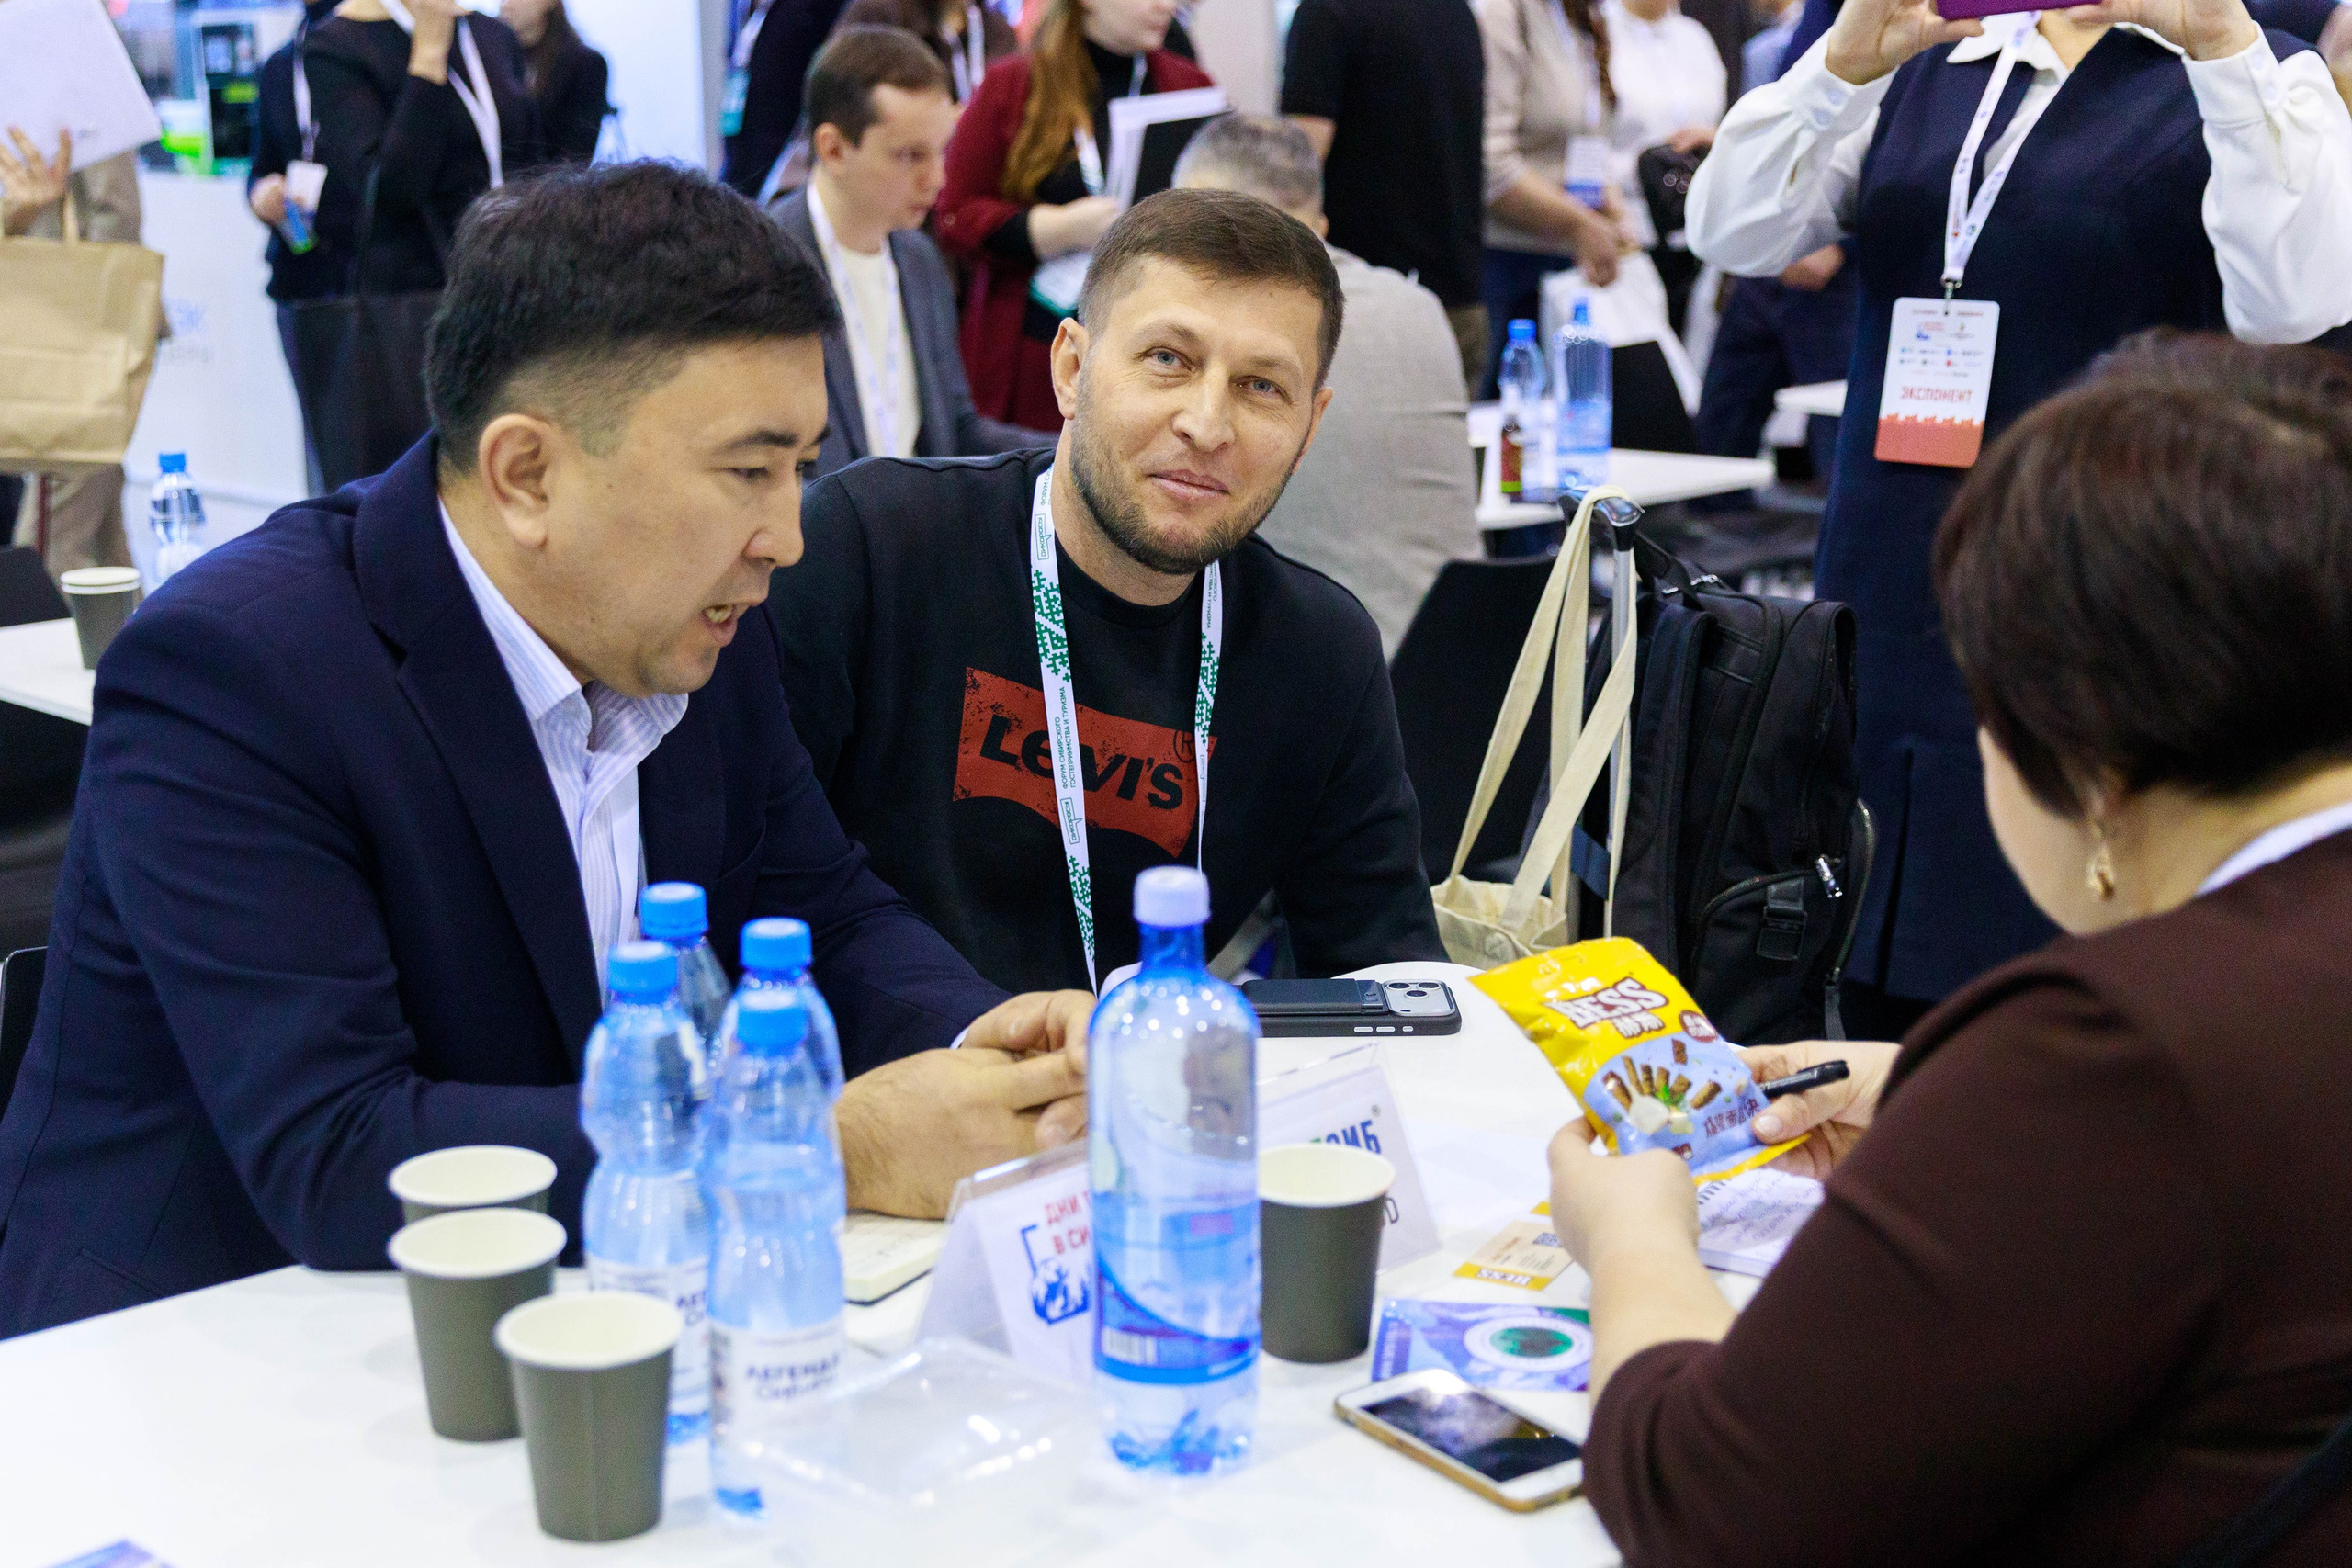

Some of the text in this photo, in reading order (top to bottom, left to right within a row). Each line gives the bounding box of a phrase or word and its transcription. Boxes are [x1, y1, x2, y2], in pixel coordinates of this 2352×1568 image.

[1059, 686, 1069, 719] ТУРИЗМА
[1055, 716, 1066, 763] СИБИРСКОГО
[1064, 726, 1076, 788] ГОСТЕПРИИМСТВА
